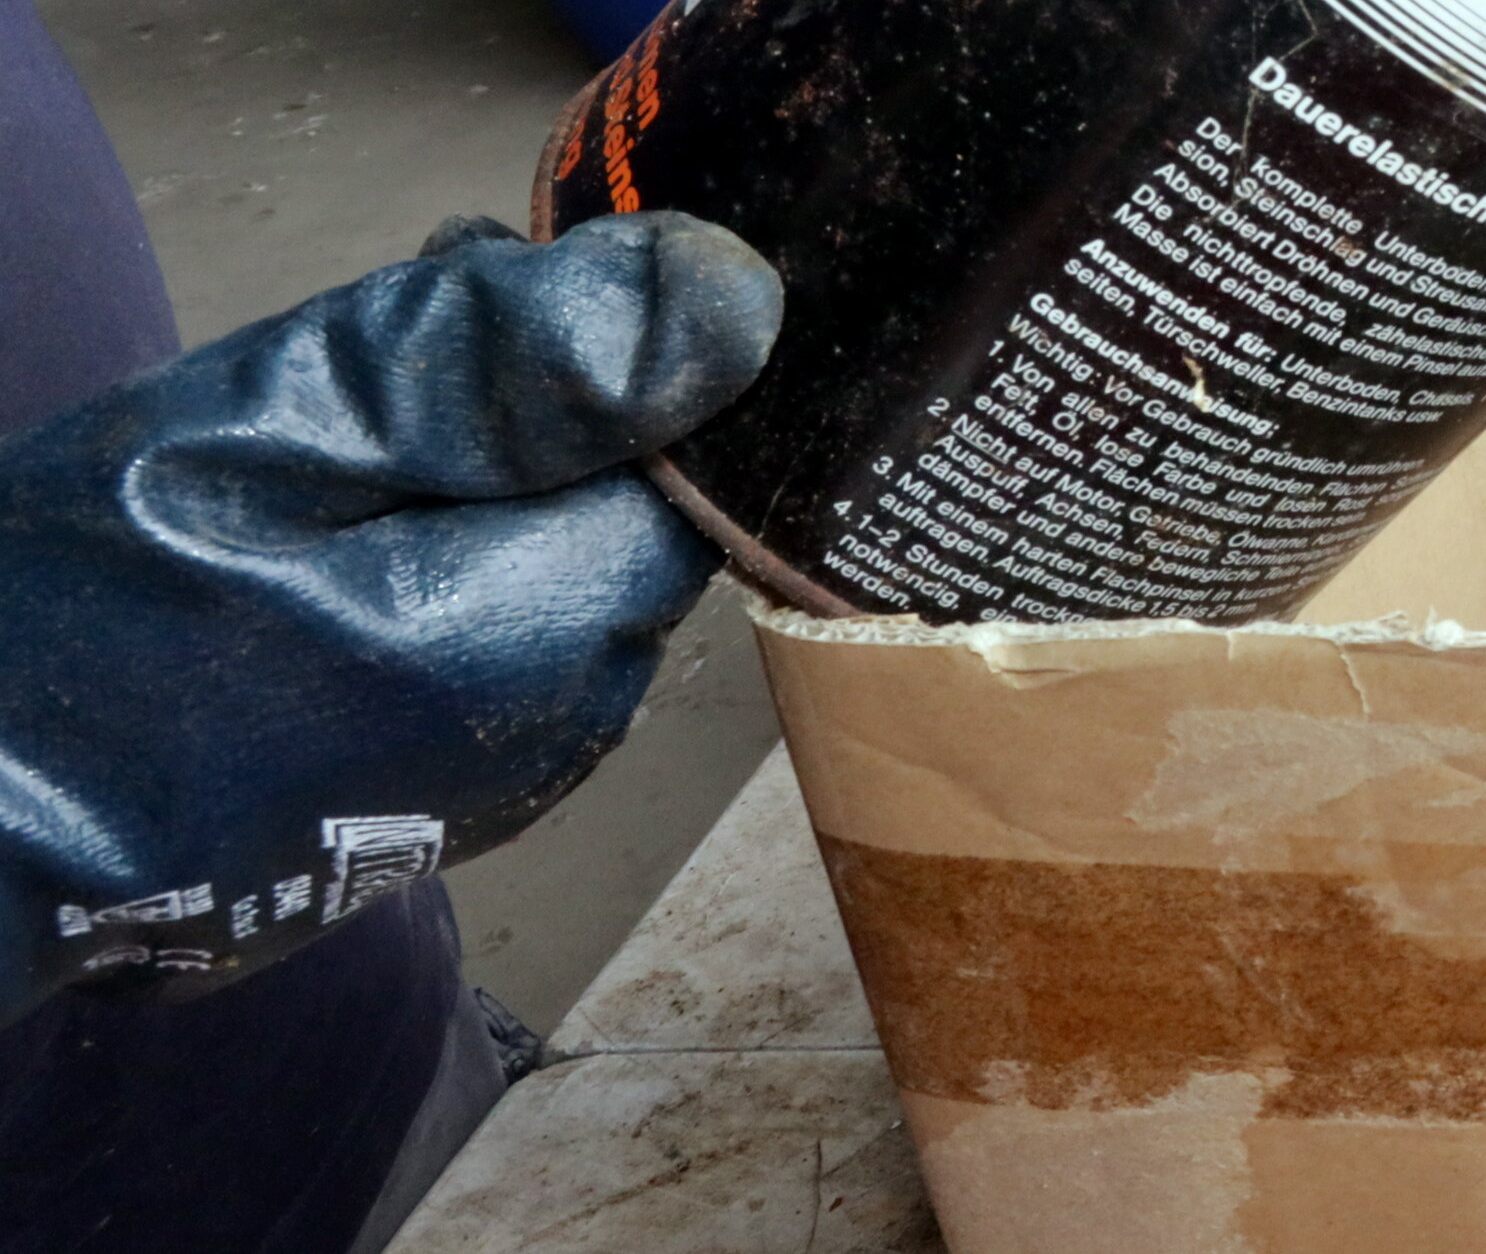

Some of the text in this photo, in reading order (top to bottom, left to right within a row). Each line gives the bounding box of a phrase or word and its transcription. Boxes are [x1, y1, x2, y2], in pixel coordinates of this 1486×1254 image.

[1153, 163, 1276, 249] Absorbiert
[1272, 239, 1368, 300] Dröhnen
[1370, 292, 1412, 320] und
[1178, 139, 1230, 187] sion,
[1233, 177, 1366, 267] Steinschlag
[1367, 255, 1411, 287] und
[1196, 116, 1244, 156] Der
[1250, 155, 1363, 234] komplette
[1080, 239, 1401, 404] Anzuwenden für: Unterboden,
[1113, 203, 1457, 375] Masse ist einfach mit einem Pinsel
[1131, 184, 1173, 220] Die
[1183, 223, 1347, 325] nichttropfende,
[1063, 258, 1135, 318] seiten,
[1142, 305, 1285, 395] Türschweller,
[1286, 382, 1406, 422] Benzintanks
[927, 397, 950, 422] 2.
[952, 413, 1018, 465] Nicht
[1014, 454, 1060, 485] auf
[1055, 473, 1122, 519] Motor,
[1128, 504, 1221, 545] Getriebe,
[974, 394, 1341, 529] entfernen. Flächen müssen trocken
[988, 340, 1005, 363] 1.
[1011, 354, 1056, 393] Von
[1060, 390, 1119, 430] allen
[1126, 427, 1158, 448] zu
[1162, 441, 1313, 495] behandelnden
[1319, 481, 1388, 497] Flächen
[991, 373, 1039, 416] Fett,
[1052, 409, 1085, 440] Öl,
[1095, 434, 1145, 468] lose
[1152, 461, 1217, 495] Farbe
[1225, 488, 1270, 508] und
[1274, 496, 1326, 513] losen
[1103, 375, 1348, 476] Vor Gebrauch gründlich
[833, 498, 1004, 600] 4. Stunden
[872, 455, 1231, 604] 3. Mit einem harten Flachpinsel in
[878, 493, 1222, 619] auftragen. Auftragsdicke 1,5 bis 2
[917, 452, 1016, 514] dämpfer
[1016, 508, 1066, 538] und
[1064, 530, 1145, 567] andere
[1148, 555, 1261, 583] bewegliche
[934, 434, 1030, 496] Auspuff,
[1034, 493, 1122, 540] Achsen,
[1134, 531, 1209, 563] Federn,
[823, 550, 912, 610] werden.
[838, 534, 960, 610] notwendig,
